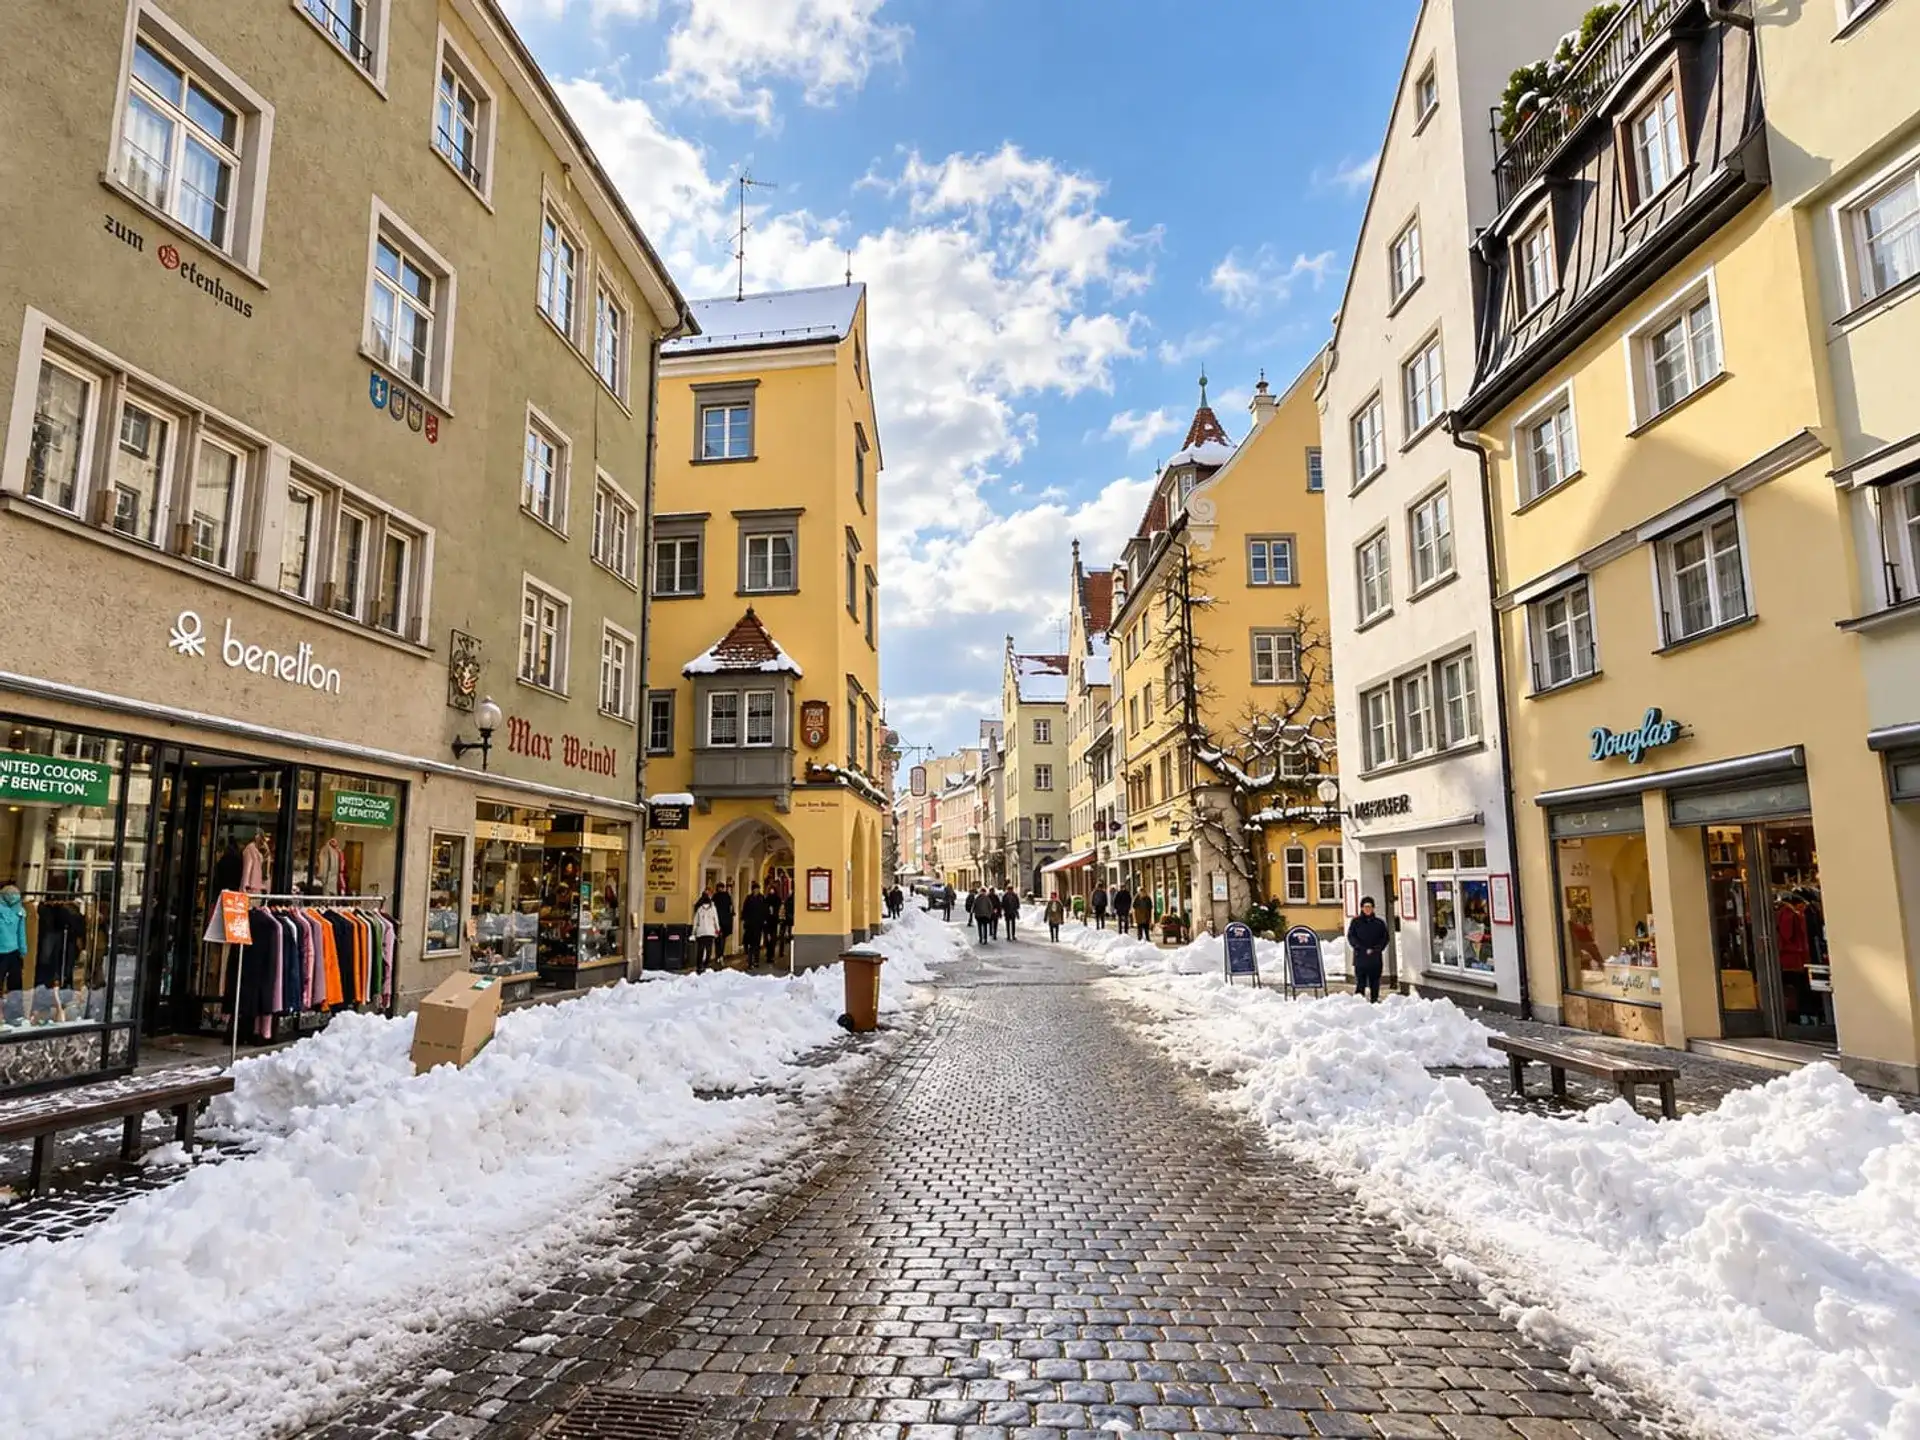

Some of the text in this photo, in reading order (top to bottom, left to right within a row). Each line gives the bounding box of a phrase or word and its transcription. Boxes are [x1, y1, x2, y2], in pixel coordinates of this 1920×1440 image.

[103, 214, 145, 253] zum
[507, 715, 617, 778] Max Weindl
[1590, 707, 1678, 764] Douglas
[0, 775, 9, 789] F
